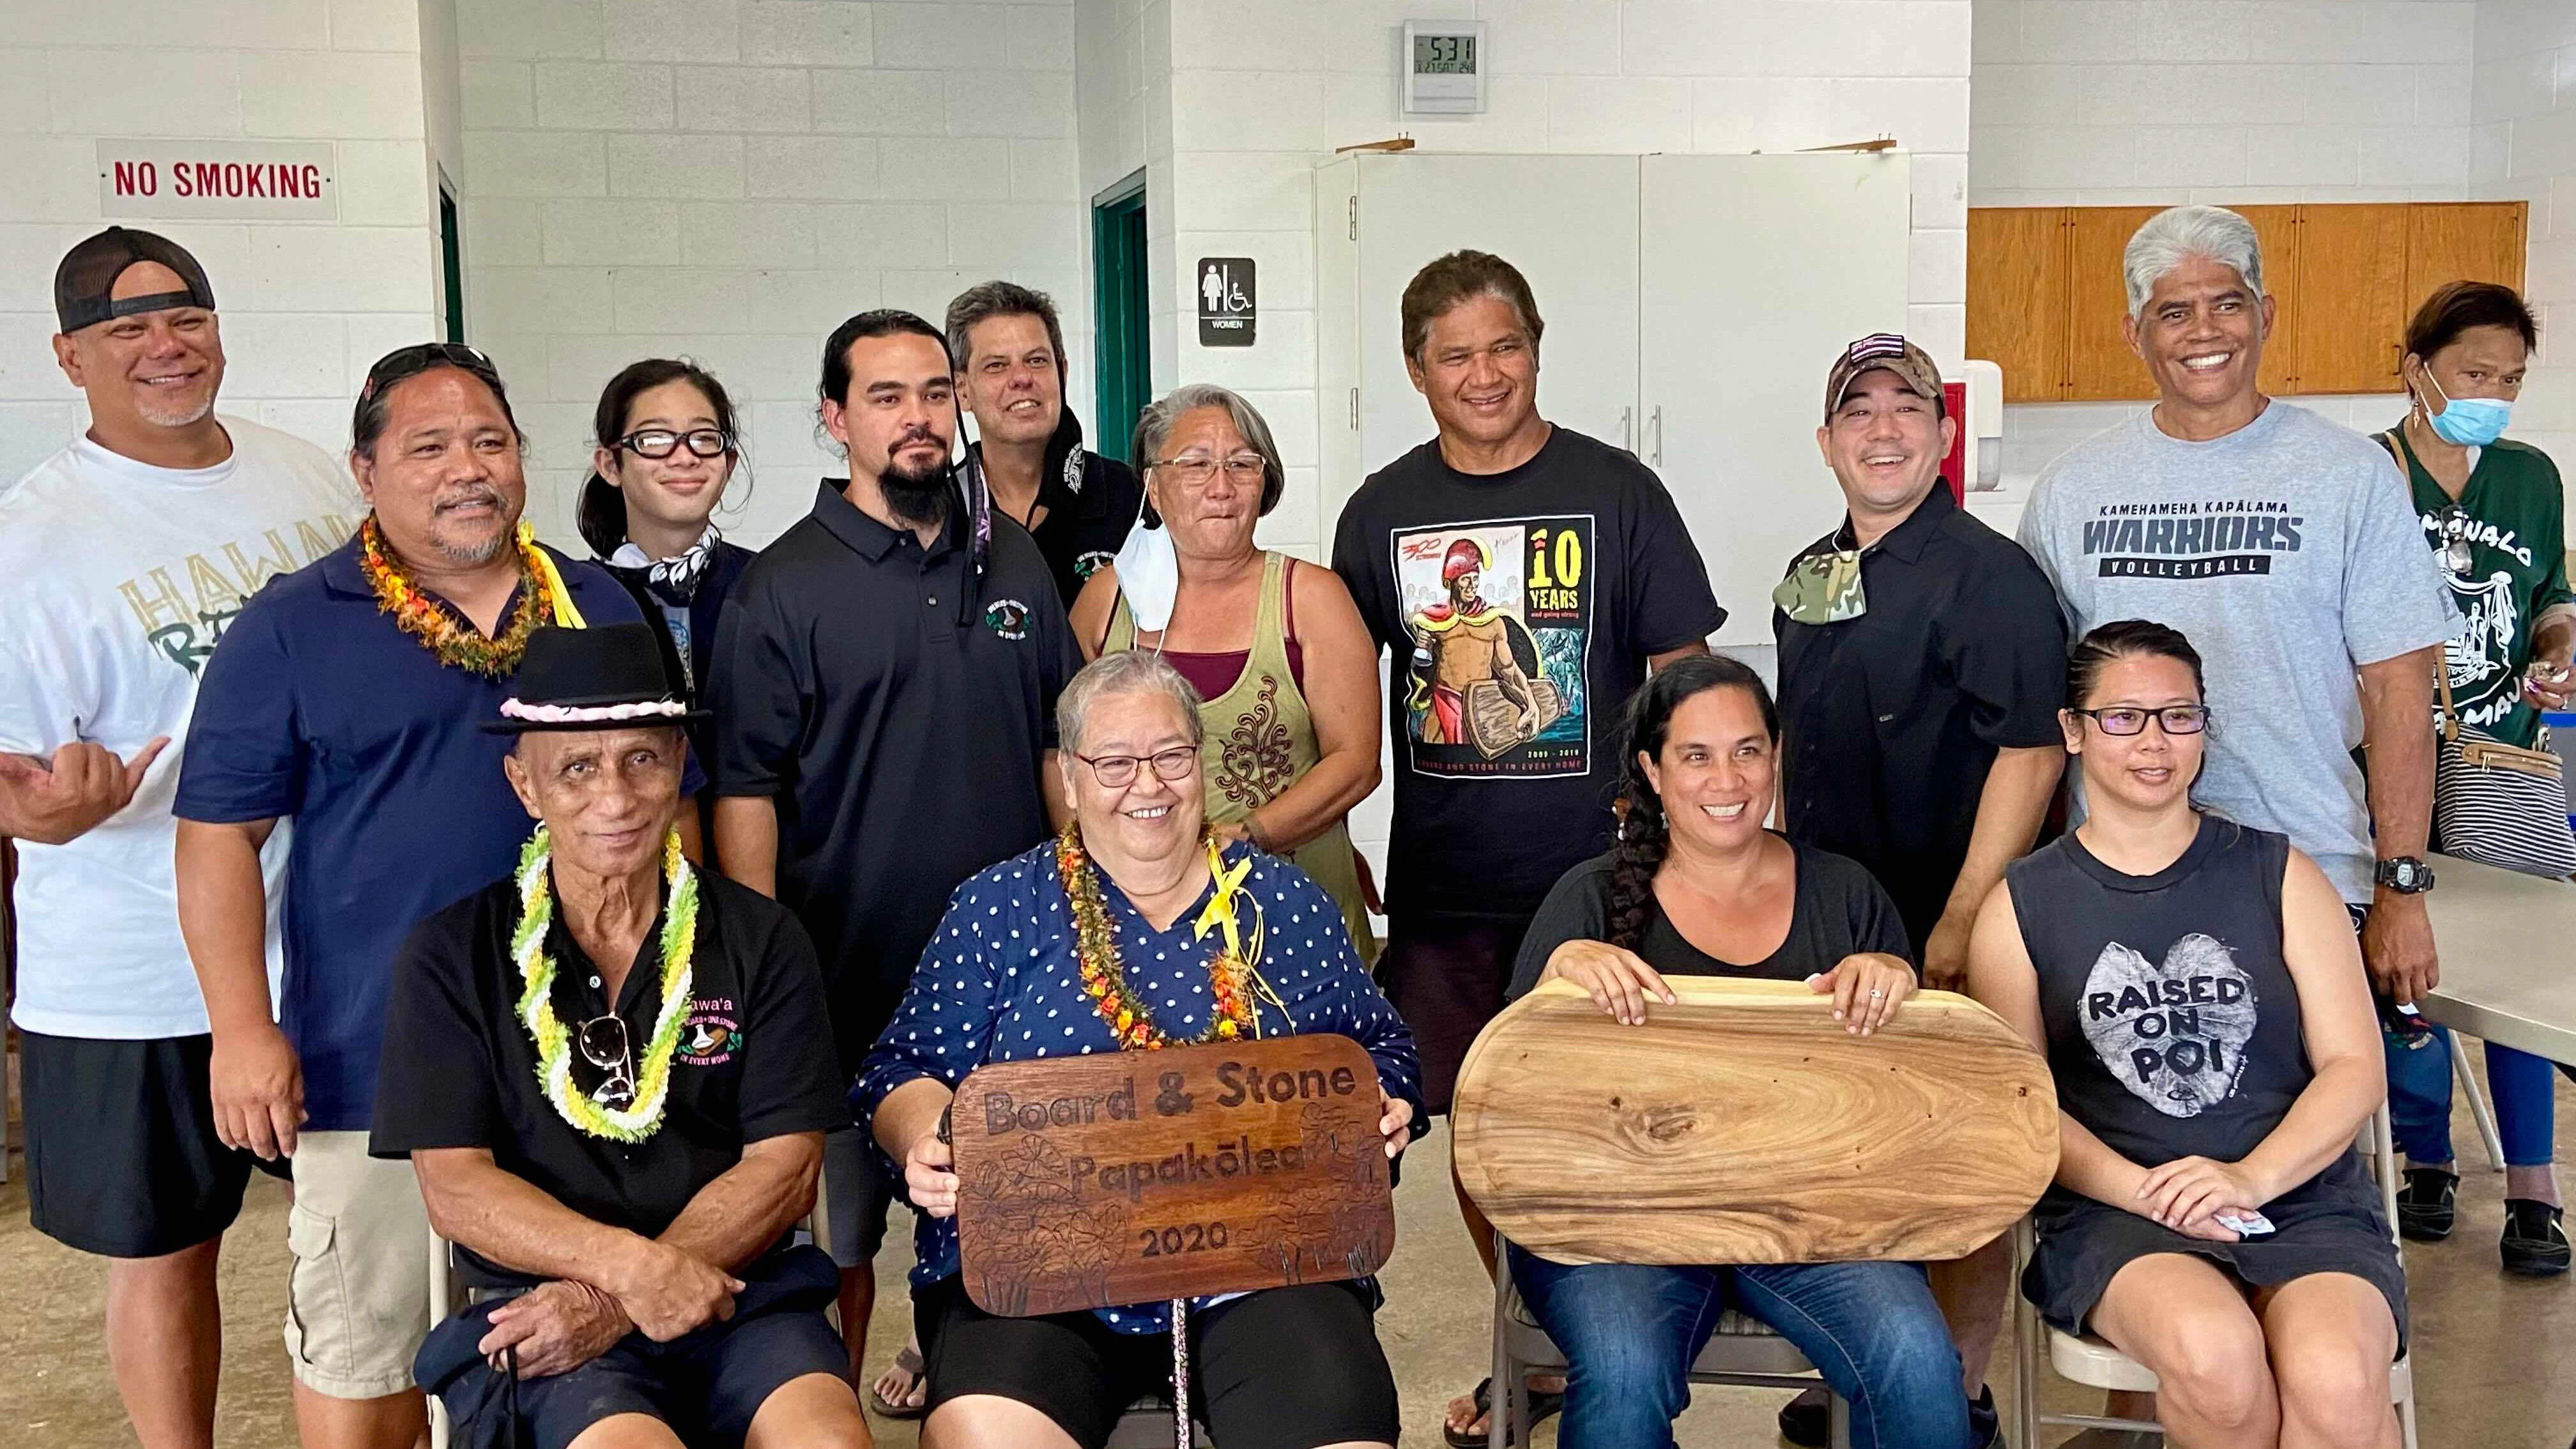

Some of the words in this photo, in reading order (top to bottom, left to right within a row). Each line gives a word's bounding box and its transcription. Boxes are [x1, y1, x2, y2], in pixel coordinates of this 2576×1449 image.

[114, 161, 157, 196] NO
[173, 162, 320, 199] SMOKING
[1211, 320, 1243, 329] WOMEN
[2099, 503, 2198, 517] KAMEHAMEHA
[2083, 516, 2304, 555] WARRIORS
[2420, 510, 2532, 568] MĀNALO
[116, 514, 351, 635] HAWAI
[1528, 528, 1583, 588] 10
[2111, 558, 2257, 576] VOLLEYBALL
[1529, 588, 1578, 611] YEARS
[1555, 760, 1581, 769] HOME
[690, 997, 733, 1011] awa'a
[2089, 976, 2244, 1021] RAISED
[2133, 1008, 2200, 1038] ON
[689, 1056, 710, 1066] EVERY
[710, 1052, 731, 1065] HOME
[2130, 1039, 2223, 1084] POI
[984, 1076, 1137, 1135] Board
[1154, 1071, 1193, 1116] &
[1216, 1061, 1356, 1107] Stone
[1069, 1135, 1305, 1202] Papakōlea
[1139, 1221, 1228, 1258] 2020
